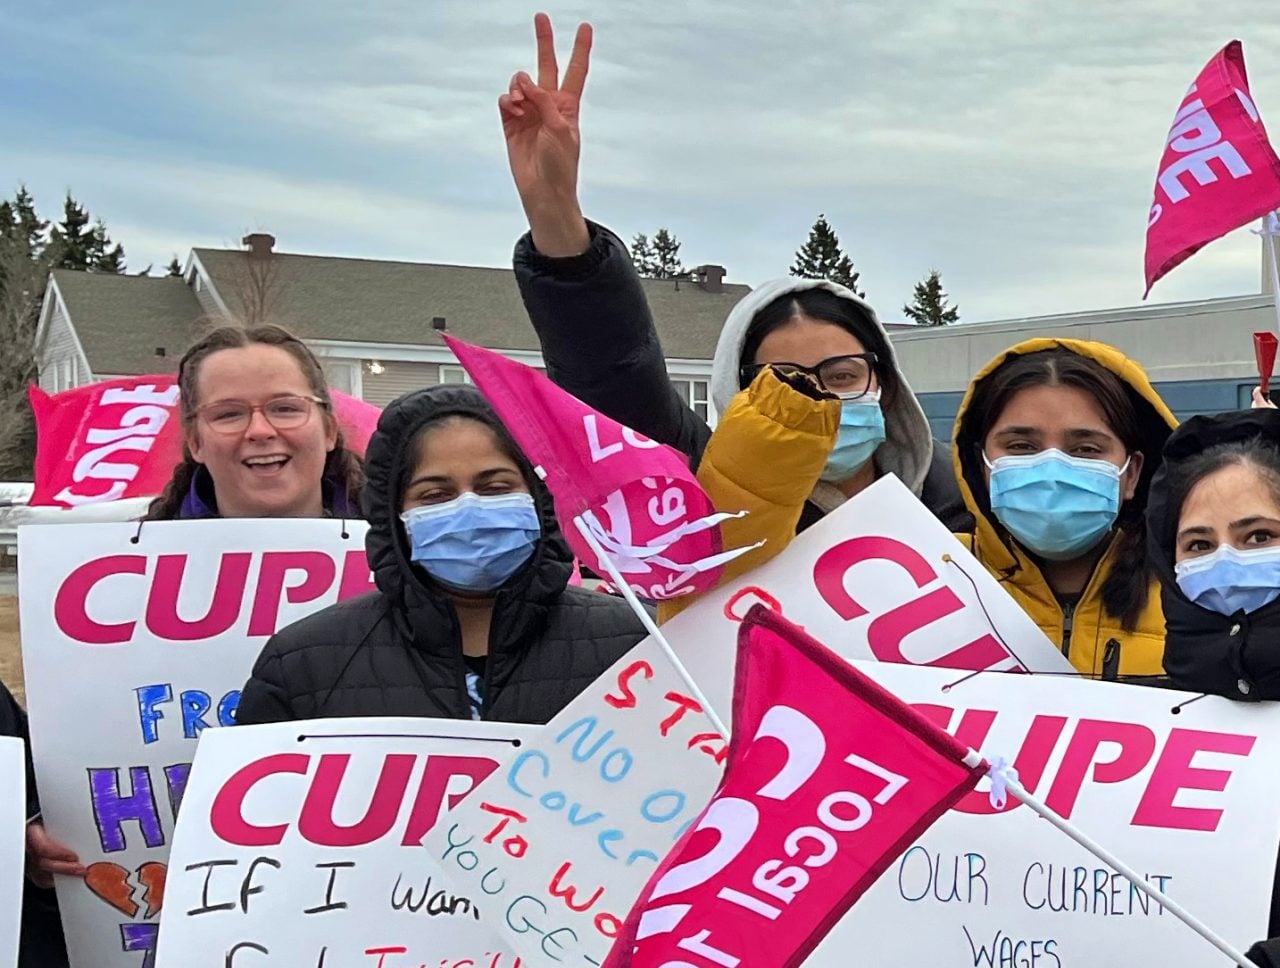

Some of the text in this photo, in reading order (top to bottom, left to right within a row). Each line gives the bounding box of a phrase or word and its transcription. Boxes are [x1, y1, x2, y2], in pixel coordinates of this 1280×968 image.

[813, 535, 1028, 674] CU
[555, 715, 634, 783] NO
[210, 752, 501, 846] CUP
[507, 749, 659, 866] Cover
[303, 861, 356, 915] I
[391, 872, 480, 921] Wan
[479, 801, 624, 938] To Wo
[899, 845, 1172, 915] OUR CURRENT
